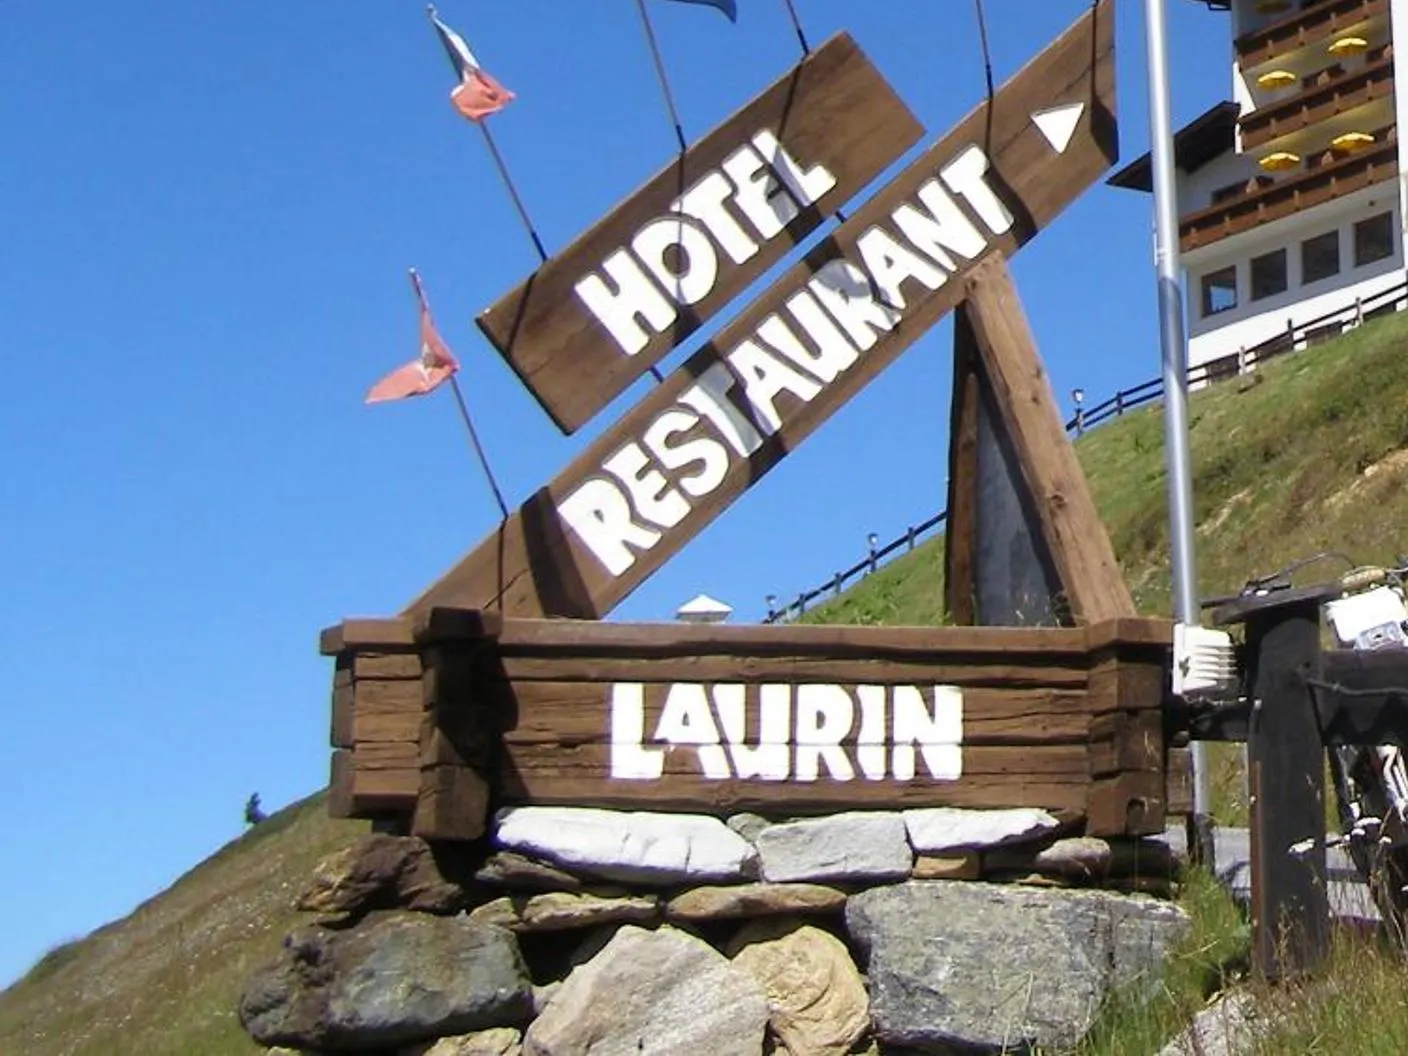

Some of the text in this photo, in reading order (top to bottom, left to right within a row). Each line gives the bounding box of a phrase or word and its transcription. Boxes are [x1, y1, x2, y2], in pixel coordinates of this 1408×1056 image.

[574, 129, 837, 356] HOTEL
[557, 144, 1015, 576] RESTAURANT
[610, 681, 964, 781] LAURIN
